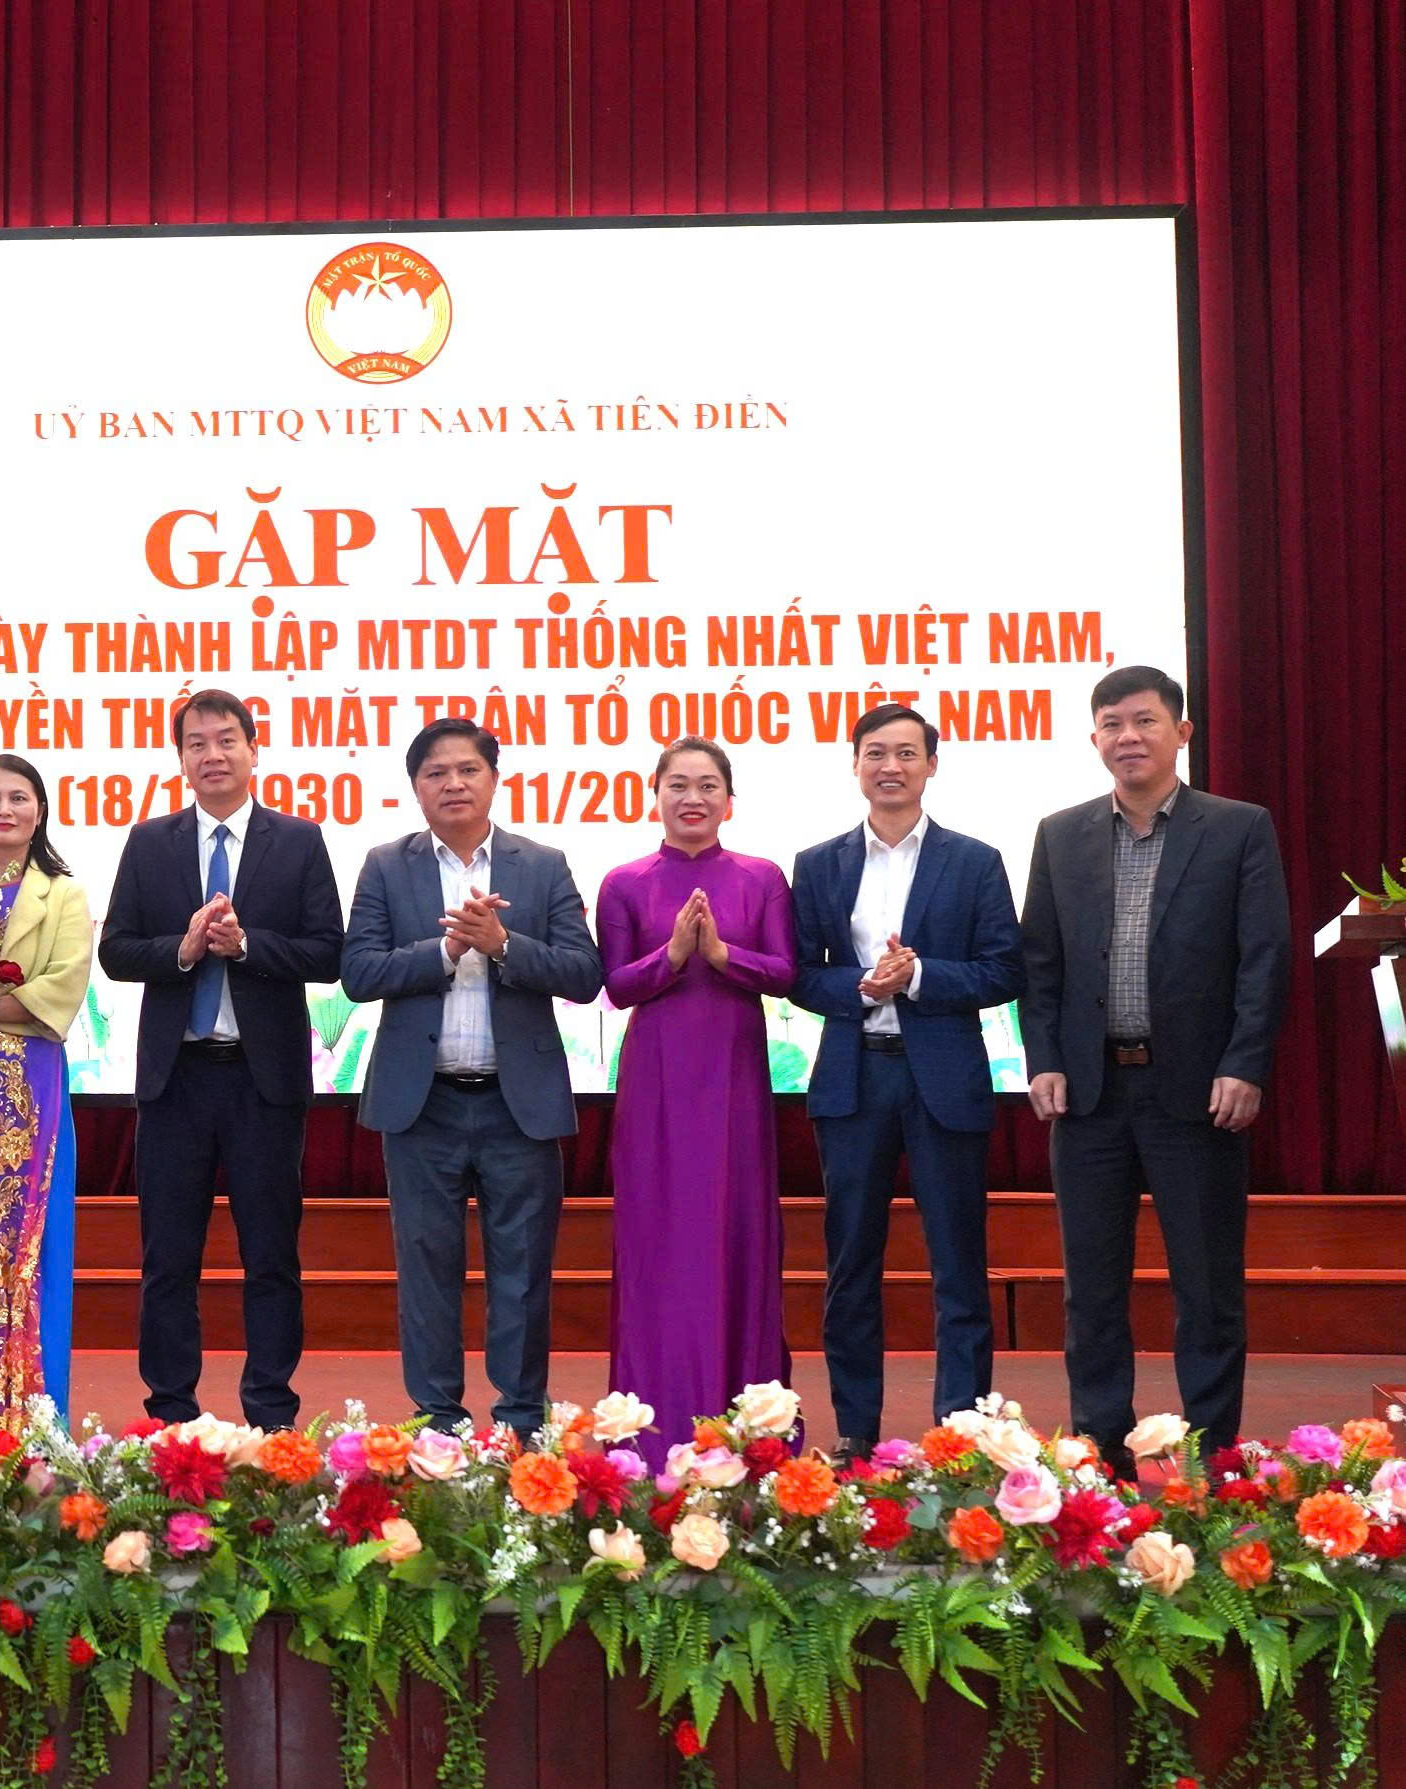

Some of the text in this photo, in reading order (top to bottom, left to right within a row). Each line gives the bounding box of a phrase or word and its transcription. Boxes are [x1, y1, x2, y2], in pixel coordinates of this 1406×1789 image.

[382, 359, 411, 374] NAM
[97, 411, 176, 440] BAN
[189, 409, 306, 442] MTTQ
[315, 403, 408, 444] VIỆT
[420, 406, 509, 434] NAM
[523, 399, 576, 433] XÃ
[588, 394, 680, 432] TIÊN
[146, 482, 673, 618] GẶP MẶT
[64, 612, 231, 674] THÀNH
[251, 611, 339, 682] LẬP
[358, 619, 498, 672] MTDT
[514, 600, 687, 670] THỐNG
[707, 597, 841, 667] NHẤT
[857, 603, 970, 676] VIỆT
[988, 612, 1116, 667] NAM,
[101, 680, 272, 750] THỐG
[291, 687, 398, 758] MẶT
[564, 674, 629, 747] TỔ
[649, 674, 790, 752] QUỐC
[938, 689, 1053, 743] NAM
